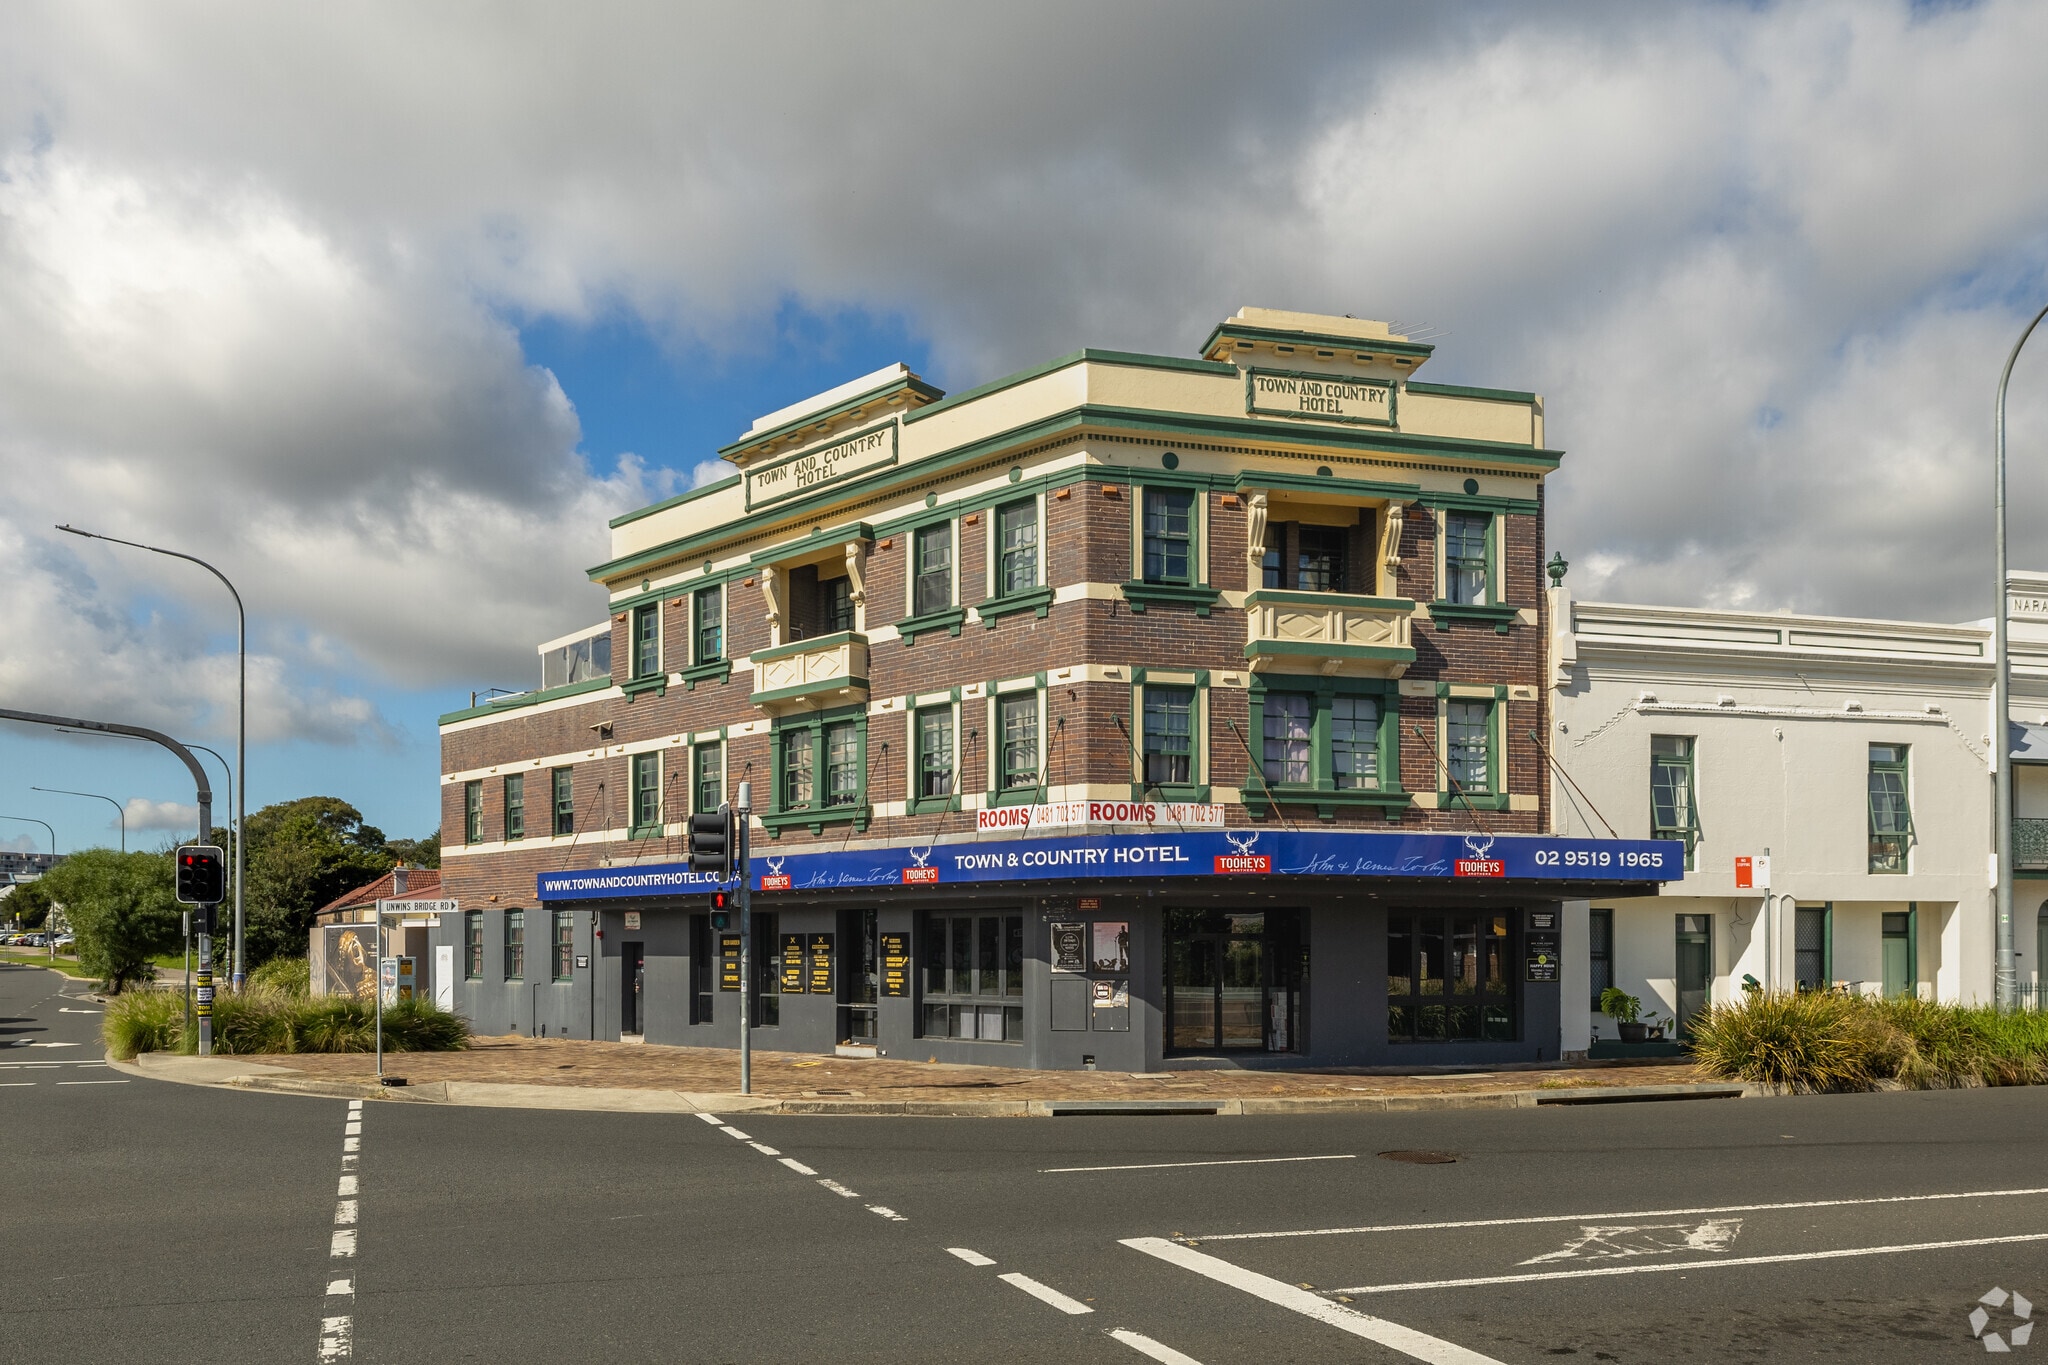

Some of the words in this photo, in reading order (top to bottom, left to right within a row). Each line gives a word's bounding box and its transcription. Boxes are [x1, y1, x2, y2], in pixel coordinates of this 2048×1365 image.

[1256, 377, 1297, 394] TOWN
[1299, 381, 1322, 396] AND
[1325, 384, 1387, 404] COUNTRY
[1299, 396, 1344, 414] HOTEL
[757, 465, 788, 488] TOWN
[794, 456, 816, 476] AND
[824, 431, 885, 464] COUNTRY
[796, 463, 838, 488] HOTEL
[978, 806, 1030, 829] ROOMS
[1036, 805, 1054, 825] 0481
[1055, 803, 1070, 823] 702
[1071, 803, 1085, 822] 577
[1089, 802, 1157, 823] ROOMS
[1166, 803, 1187, 823] 0481
[1190, 804, 1206, 823] 702
[1208, 804, 1225, 823] 577
[954, 853, 1004, 870] TOWN
[1006, 851, 1019, 868] &
[1022, 847, 1107, 867] COUNTRY
[1114, 845, 1190, 863] HOTEL
[1219, 857, 1266, 869] TOOHEYS
[1458, 861, 1500, 873] TOOHEYS
[1534, 849, 1561, 866] 02
[1564, 850, 1612, 867] 9519
[1618, 851, 1664, 868] 1965
[763, 876, 789, 887] TOOHEYS
[905, 868, 936, 880] TOOHEYS
[386, 902, 411, 912] UNWINS
[414, 901, 437, 911] BRIDGE
[440, 901, 449, 910] RD
